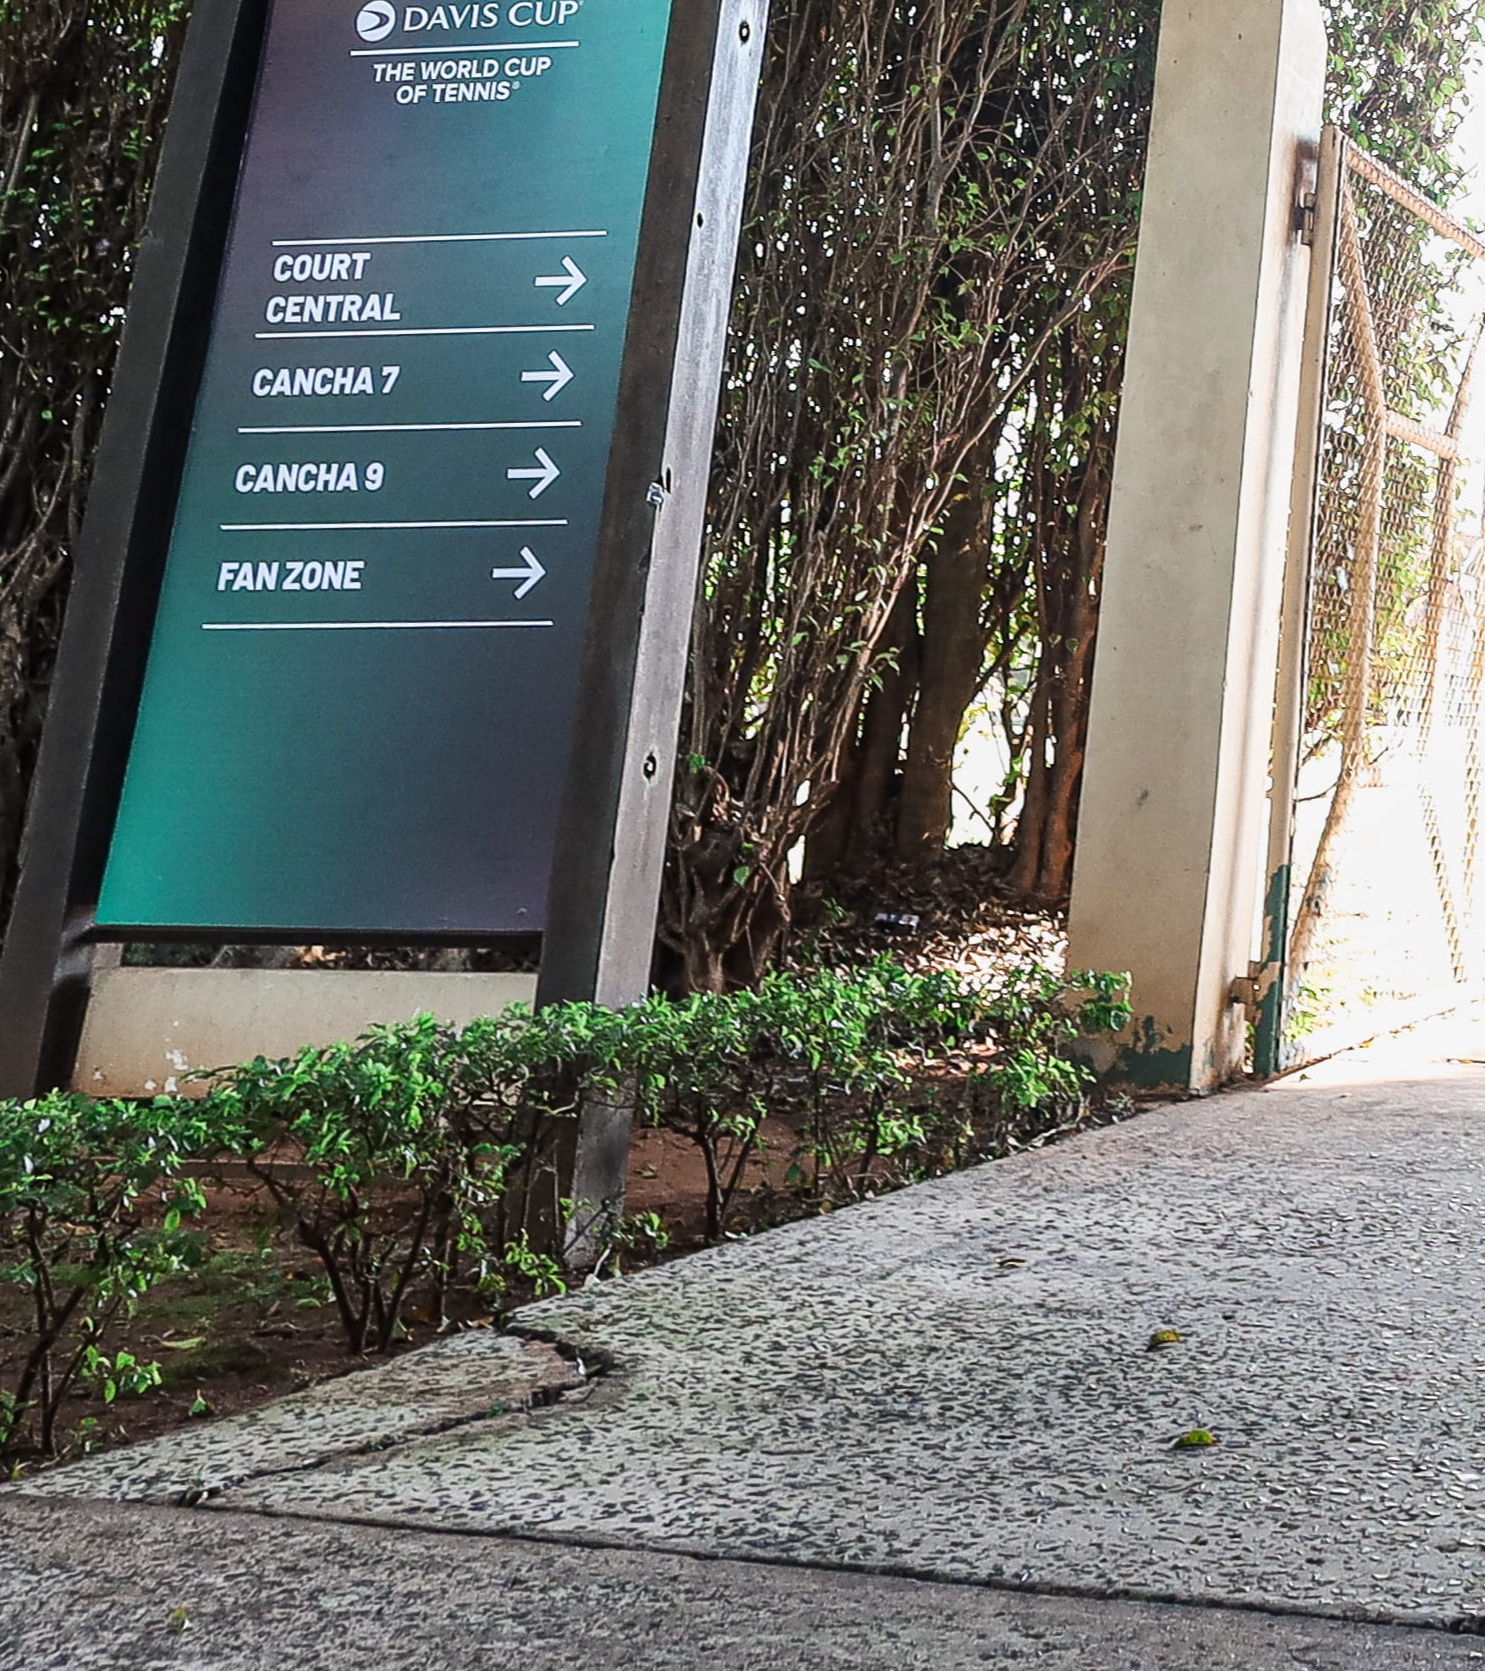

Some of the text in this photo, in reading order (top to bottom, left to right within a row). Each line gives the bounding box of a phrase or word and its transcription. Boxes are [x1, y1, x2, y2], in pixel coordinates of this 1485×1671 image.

[403, 3, 499, 32] DAVIS
[373, 56, 552, 82] THE WORLD CUP
[396, 85, 428, 104] OF
[273, 252, 372, 282] COURT
[266, 293, 401, 323] CENTRAL
[252, 365, 401, 397] CANCHA 7
[235, 462, 385, 493] CANCHA 9
[217, 560, 365, 591] FAN ZONE
